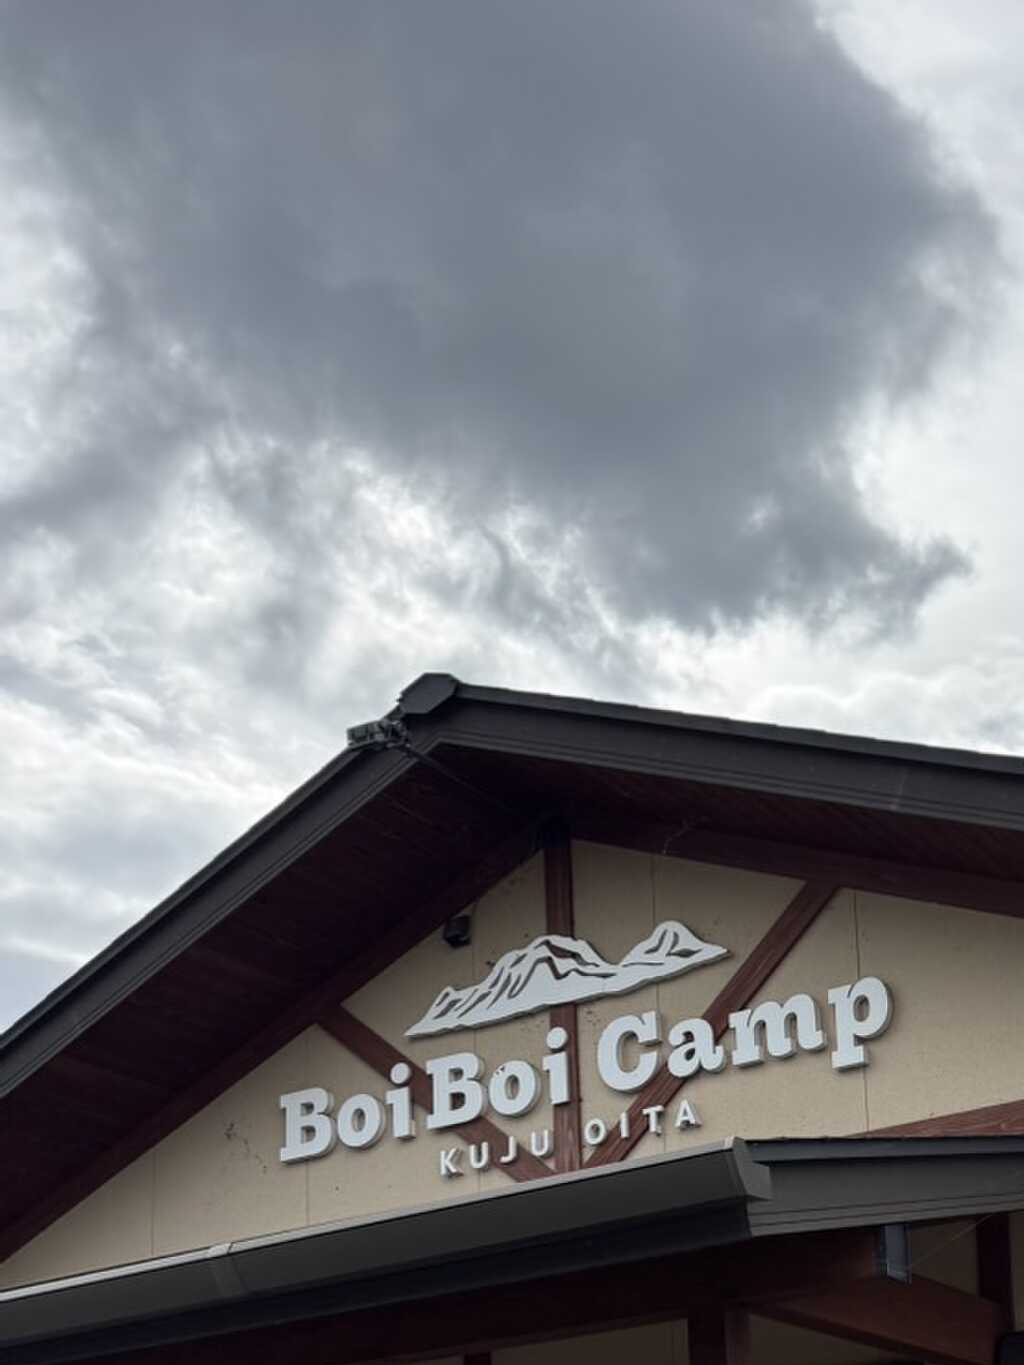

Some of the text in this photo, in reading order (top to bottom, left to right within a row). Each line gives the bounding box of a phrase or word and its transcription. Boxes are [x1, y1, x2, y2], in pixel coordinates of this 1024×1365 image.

[280, 975, 893, 1165] Boi Boi Camp
[439, 1099, 701, 1178] KUJU OITA
